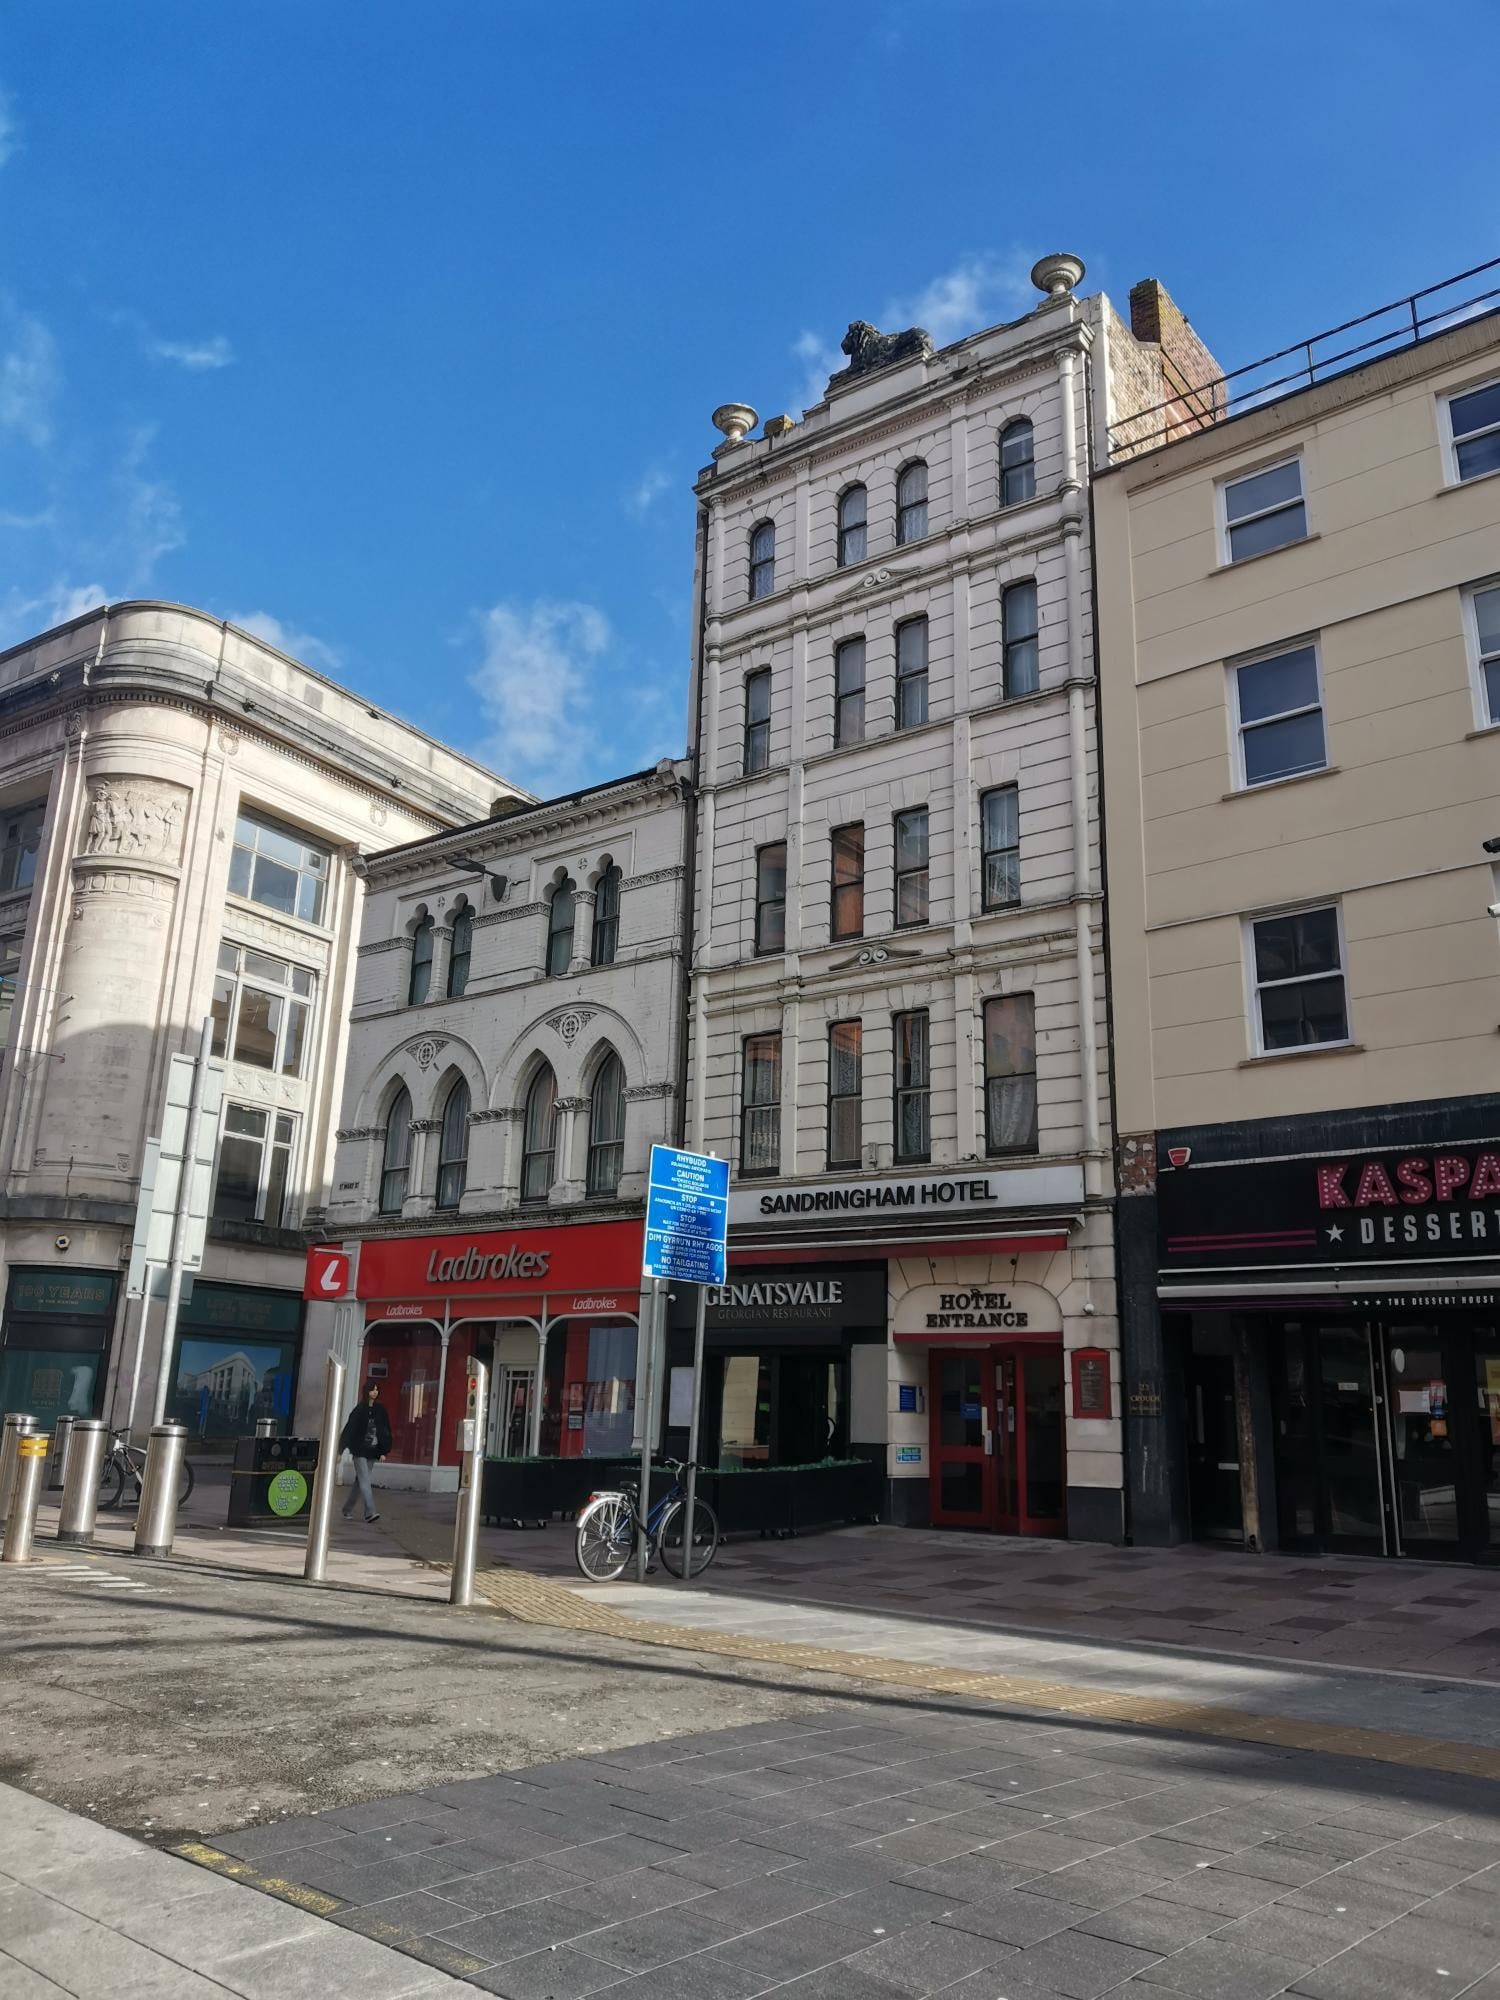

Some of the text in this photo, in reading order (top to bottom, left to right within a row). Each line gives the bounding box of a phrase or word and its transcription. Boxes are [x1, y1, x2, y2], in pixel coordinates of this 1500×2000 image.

[677, 1170, 705, 1182] CAUTION
[682, 1194, 697, 1204] STOP
[759, 1180, 998, 1214] SANDRINGHAM HOTEL
[680, 1214, 696, 1223] STOP
[649, 1233, 661, 1242] DIM
[692, 1240, 705, 1249] RHY
[706, 1243, 723, 1252] AGOS
[426, 1244, 551, 1283] Ladbrokes
[661, 1256, 709, 1270] NO TAILGATING
[48, 1286, 104, 1301] YEARS
[705, 1281, 843, 1306] GENATSVALE
[1412, 1296, 1456, 1305] DESSERT
[1461, 1295, 1495, 1304] HOUSE
[573, 1297, 617, 1310] Ladbrokes
[939, 1293, 1012, 1310] HOTEL
[386, 1303, 424, 1316] Ladbrokes
[718, 1307, 832, 1320] GEORGIAN RESTAURANT
[926, 1312, 1028, 1328] ENTRANCE
